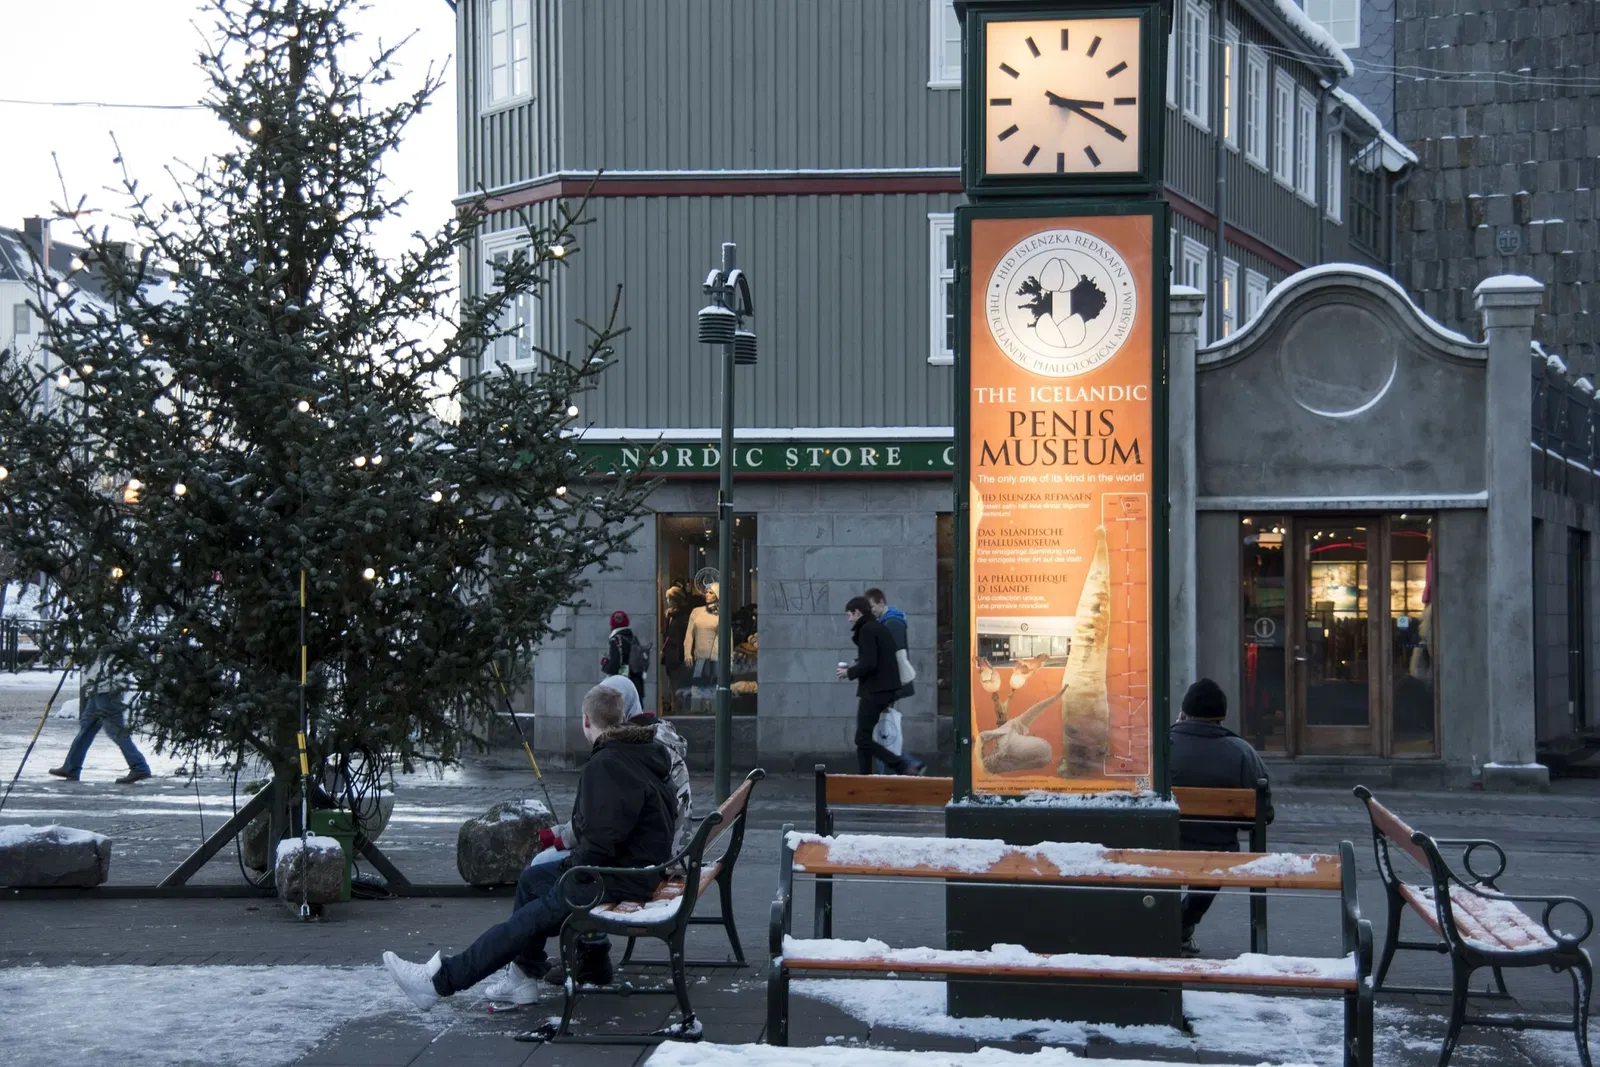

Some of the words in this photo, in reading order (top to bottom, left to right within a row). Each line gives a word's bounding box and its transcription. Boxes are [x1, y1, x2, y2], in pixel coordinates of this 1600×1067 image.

[997, 258, 1015, 279] HIÐ
[1015, 234, 1070, 258] ÍSLENZKA
[990, 293, 1000, 314] THE
[1114, 292, 1132, 340] MUSEUM
[993, 317, 1028, 365] ICELANDIC
[1033, 339, 1118, 372] PHALLOLOGICAL
[974, 388, 1016, 403] THE
[1030, 385, 1148, 402] ICELANDIC
[1007, 409, 1114, 438] PENIS
[786, 447, 901, 466] STORE
[977, 437, 1144, 467] MUSEUM
[978, 474, 995, 483] The
[997, 475, 1017, 485] only
[1040, 474, 1049, 482] of
[1051, 474, 1063, 482] its
[1065, 474, 1084, 482] kind
[1087, 474, 1096, 482] in
[1098, 473, 1113, 482] the
[1116, 473, 1145, 482] world!
[999, 492, 1042, 501] ÍSLENZKA
[977, 528, 996, 537] DAS
[977, 539, 1060, 547] PHALLUSMUSEUM
[978, 575, 988, 583] LA
